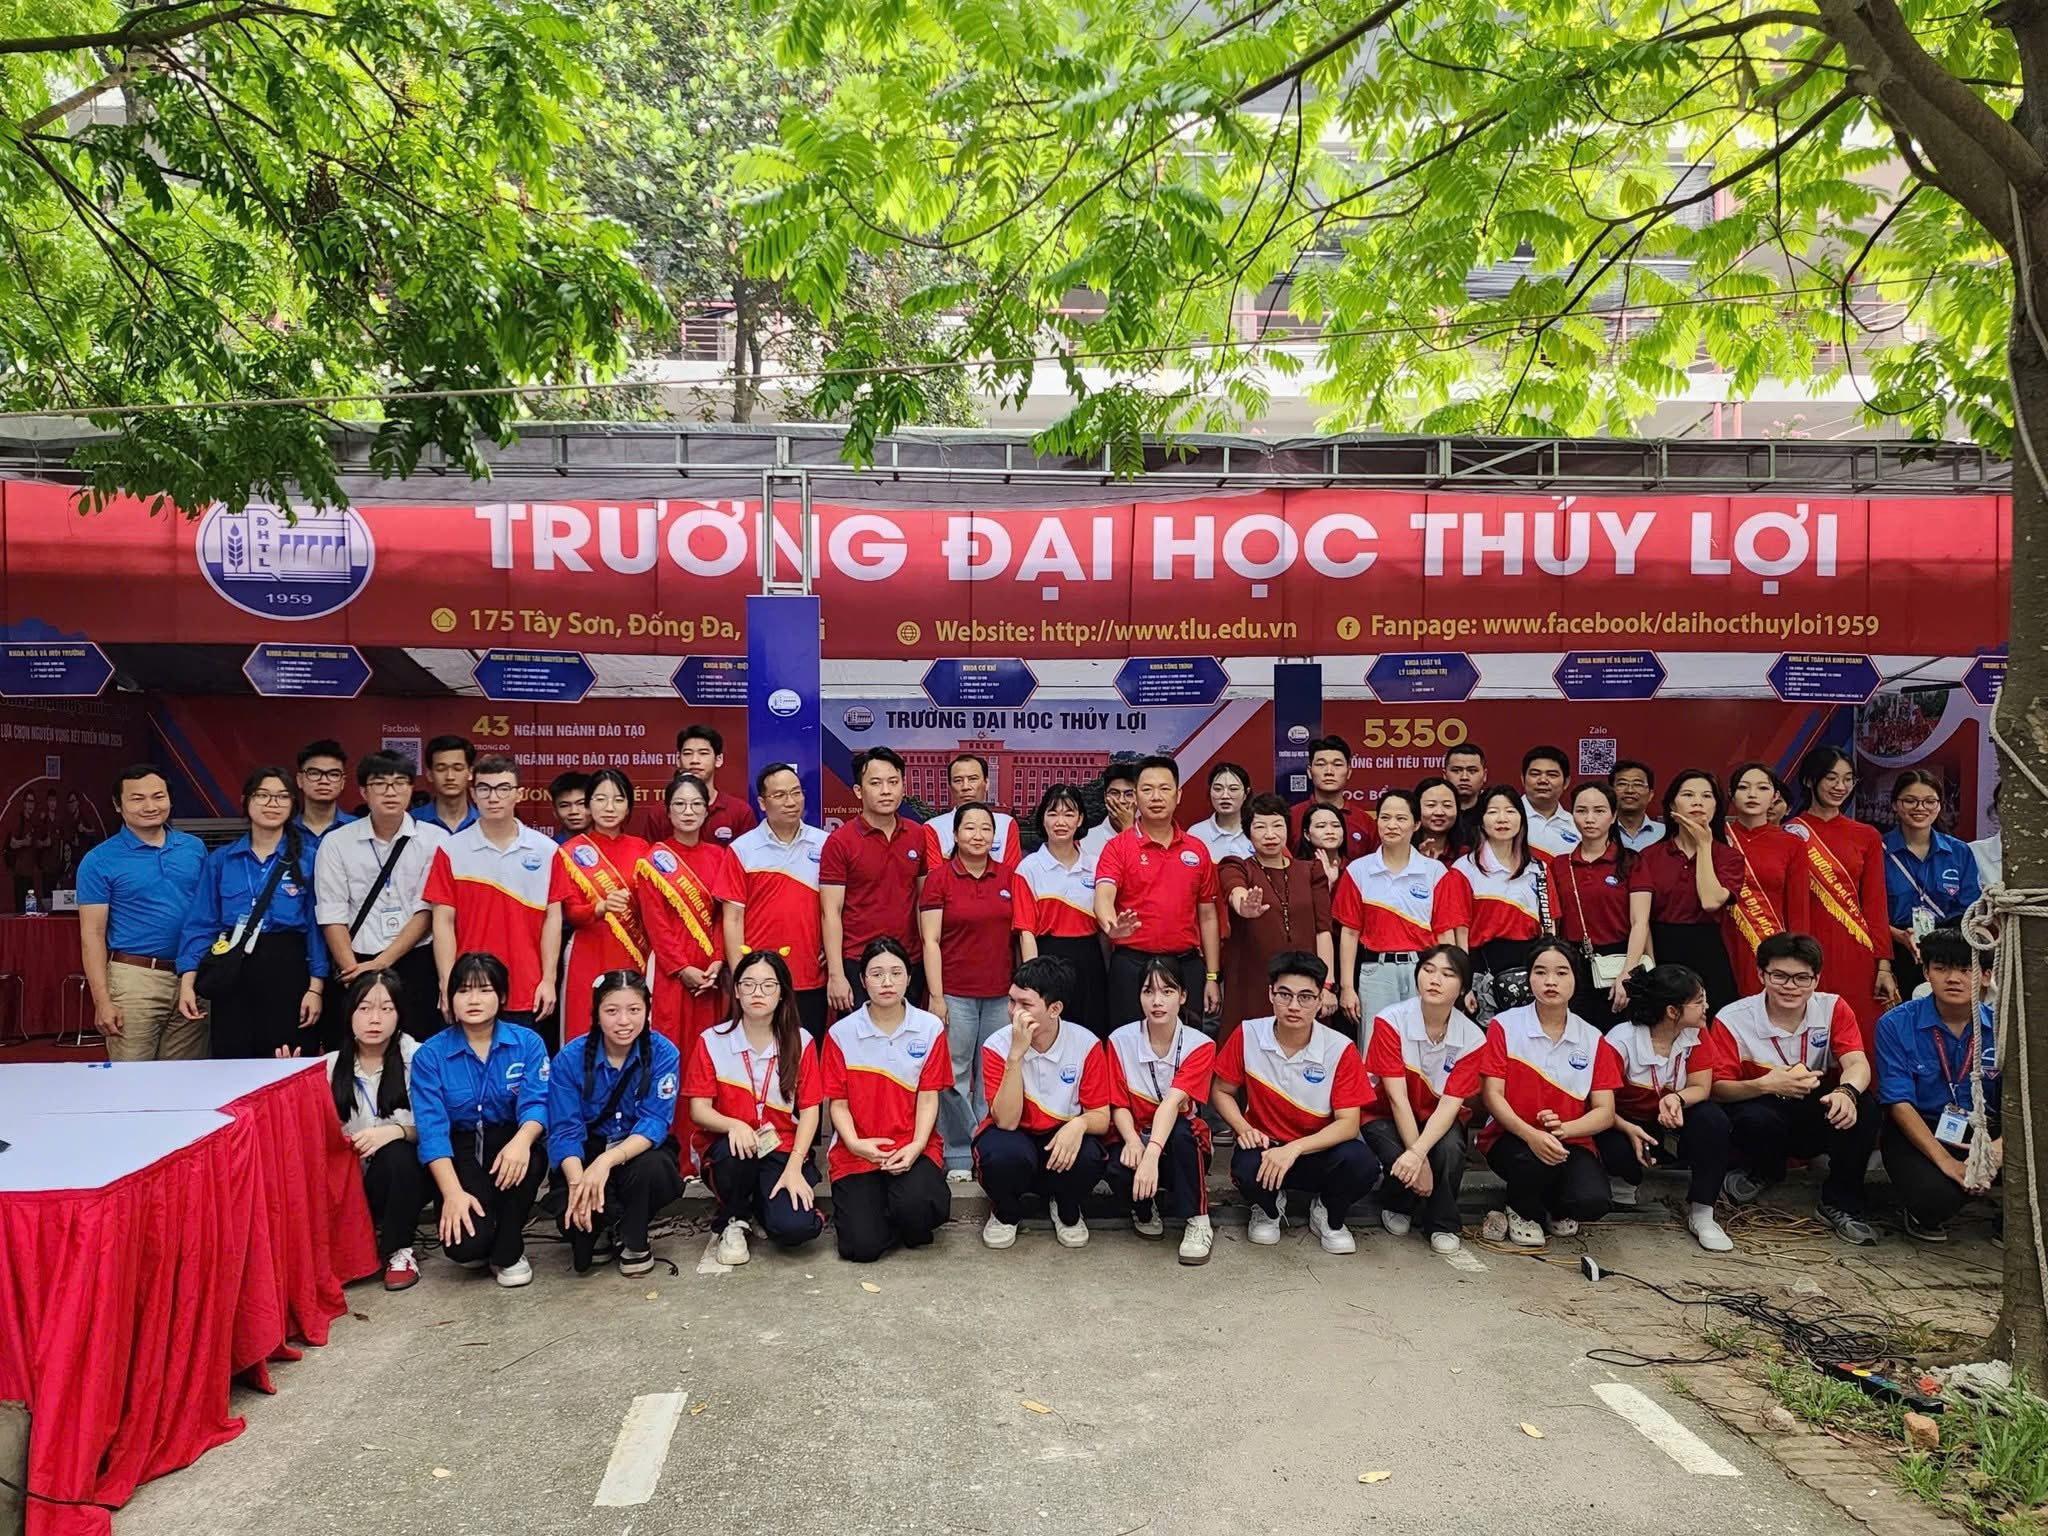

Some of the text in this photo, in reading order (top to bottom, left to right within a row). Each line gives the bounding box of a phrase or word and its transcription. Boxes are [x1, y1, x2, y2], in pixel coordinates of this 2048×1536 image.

[941, 516, 1113, 601] ĐẠI
[1153, 513, 1379, 598] HỌC
[1691, 503, 1837, 595] LỢI
[265, 593, 313, 605] 1959
[470, 609, 741, 643] 175 Tây Sơn, Đống Đa,
[935, 617, 1297, 647] Website: http://www.tlu.edu.vn
[1371, 611, 1880, 641] Fanpage: www.facebook/daihocthuyloi1959
[962, 664, 978, 672] KHOA
[986, 663, 997, 672] KHÍ
[382, 723, 421, 734] Facbook
[472, 715, 510, 737] 43
[885, 706, 1147, 734] TRƯỜNG ĐẠI HỌC THỦY LỢI
[514, 721, 646, 740] NGÀNH NGÀNH ĐÀO TẠO
[1362, 718, 1468, 748] 5350
[1589, 726, 1608, 735] Zalo
[515, 750, 554, 766] NGÀNH
[556, 752, 580, 768] HỌC
[582, 750, 606, 766] ĐÀO
[608, 752, 630, 768] TẠO
[633, 748, 663, 766] BẰNG
[1351, 753, 1373, 769] ỔNG
[1375, 753, 1394, 769] CHỈ
[1396, 754, 1420, 769] TIÊU
[634, 785, 650, 801] ÉT
